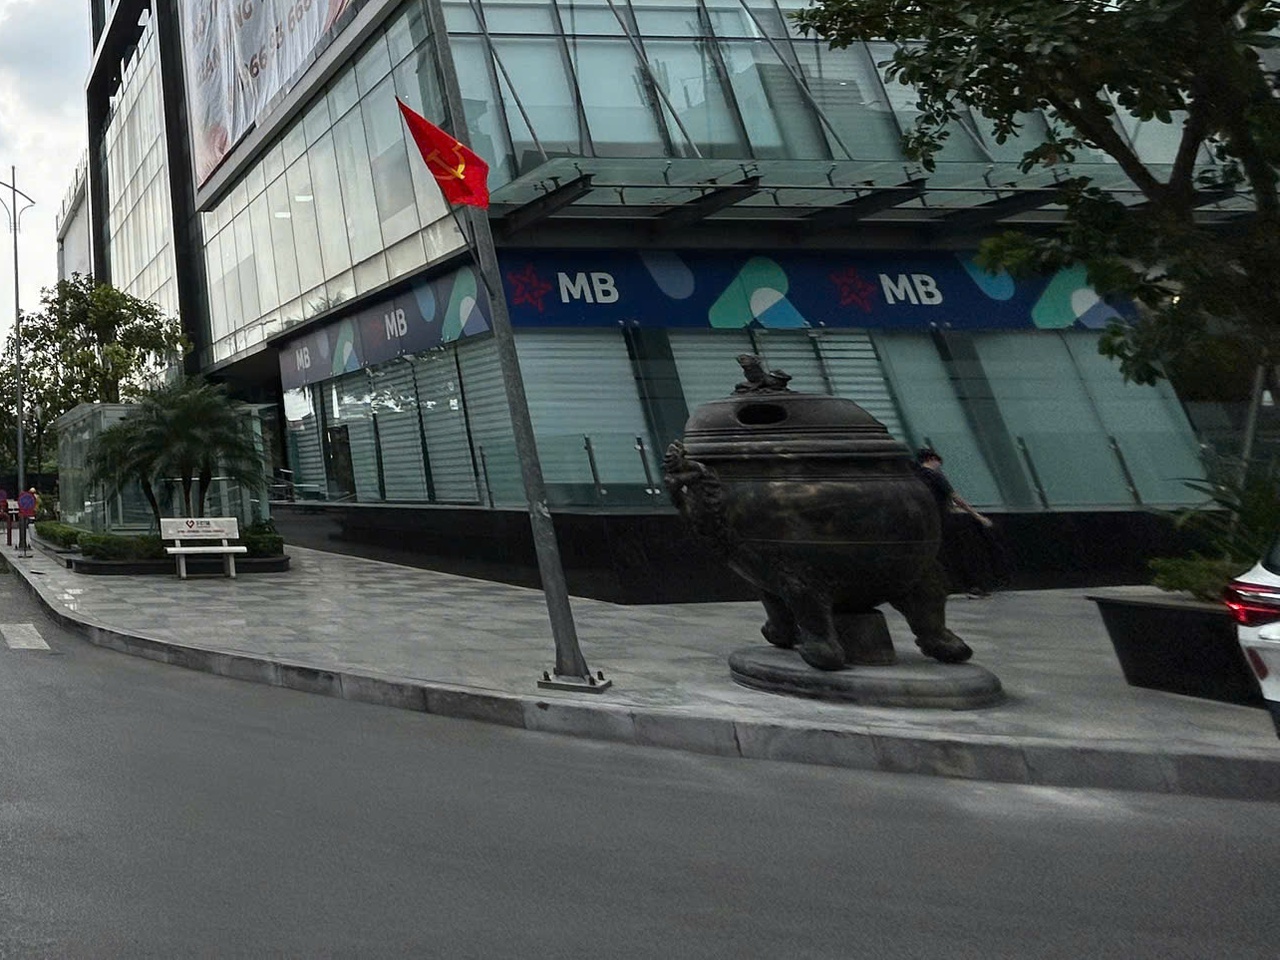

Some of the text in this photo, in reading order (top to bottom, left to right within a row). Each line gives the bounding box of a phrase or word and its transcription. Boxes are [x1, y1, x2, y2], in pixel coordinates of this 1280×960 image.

[557, 272, 619, 304] MB
[879, 273, 943, 305] MB
[385, 308, 408, 340] MB
[295, 346, 311, 370] MB
